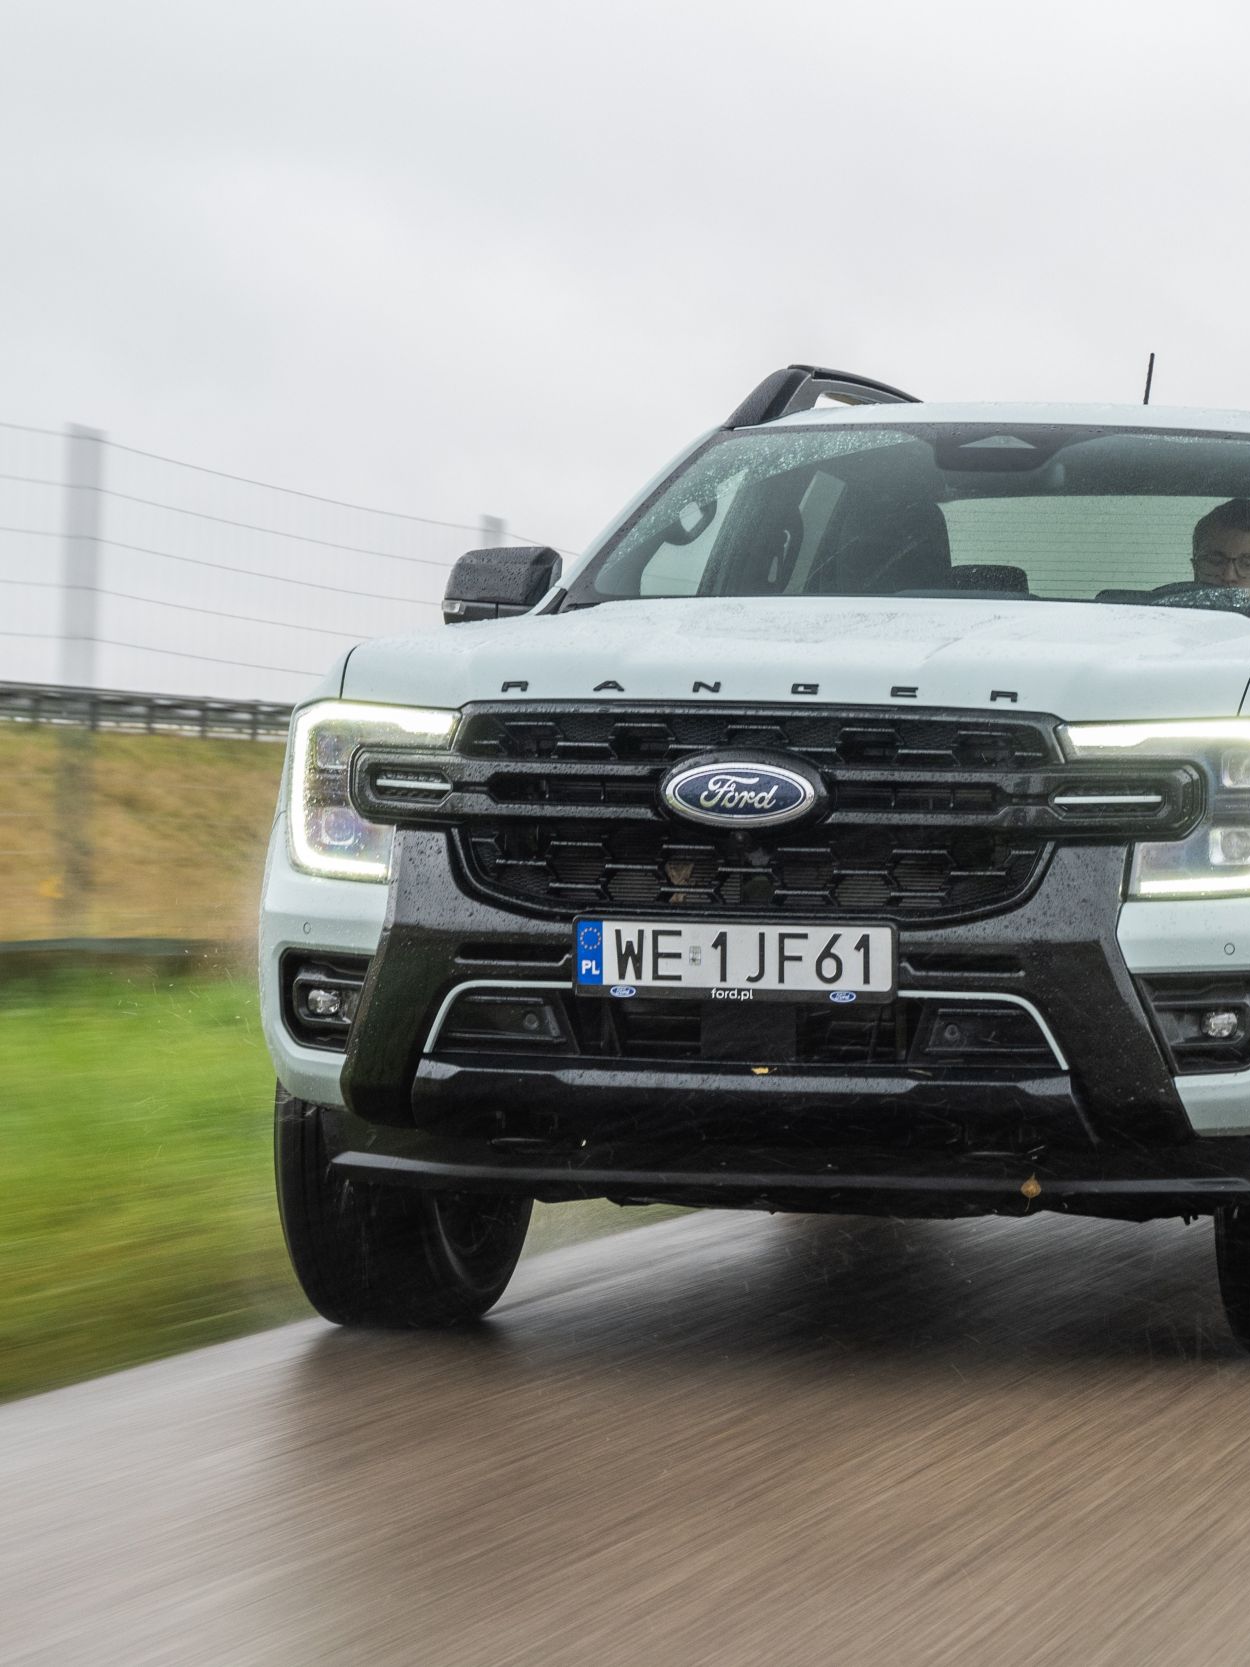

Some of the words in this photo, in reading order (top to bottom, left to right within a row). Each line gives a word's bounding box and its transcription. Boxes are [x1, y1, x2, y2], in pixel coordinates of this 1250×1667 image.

[501, 680, 1018, 703] RANGER
[700, 774, 779, 809] Ford
[581, 960, 600, 975] PL
[615, 929, 682, 981] WE
[711, 931, 870, 985] 1JF61
[711, 988, 753, 1001] ford.pl
